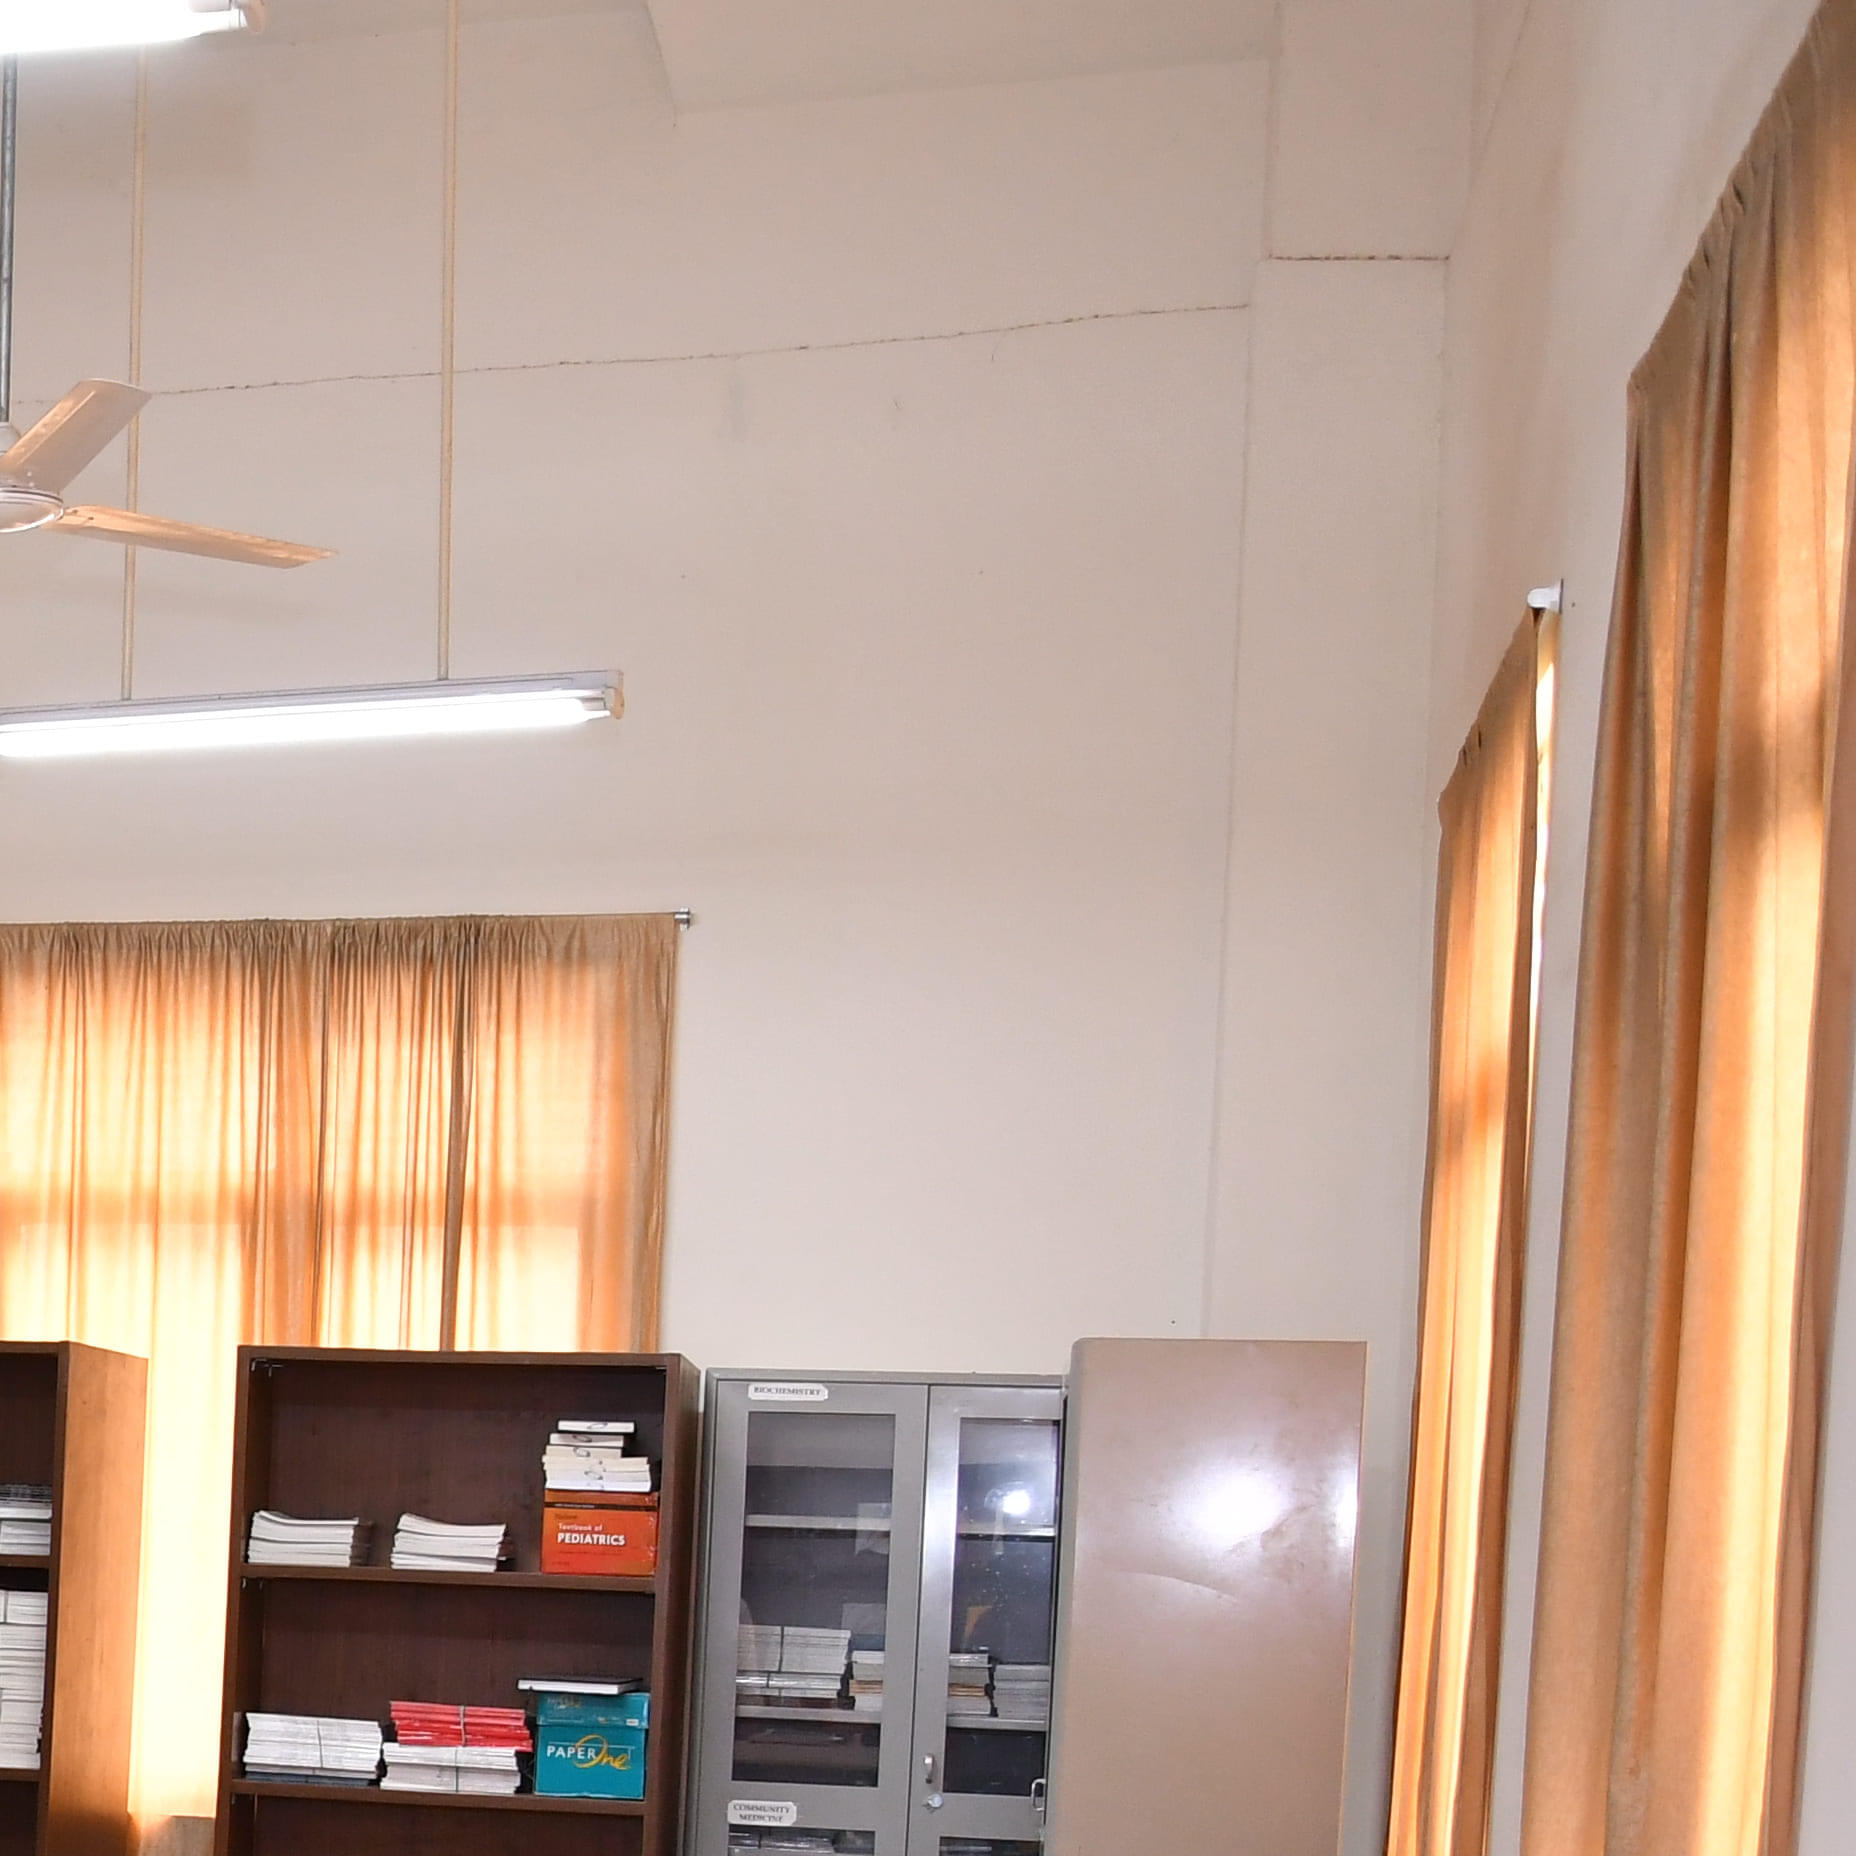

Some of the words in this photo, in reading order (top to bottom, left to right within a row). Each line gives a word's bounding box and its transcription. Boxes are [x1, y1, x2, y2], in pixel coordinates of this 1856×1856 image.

[754, 1387, 820, 1396] BIOCHEMISTRY
[559, 1523, 592, 1532] Textbook
[594, 1524, 602, 1532] of
[558, 1533, 626, 1546] PEDIATRICS
[734, 1804, 790, 1814] COMMUNITY
[740, 1814, 783, 1823] MEDICINE
